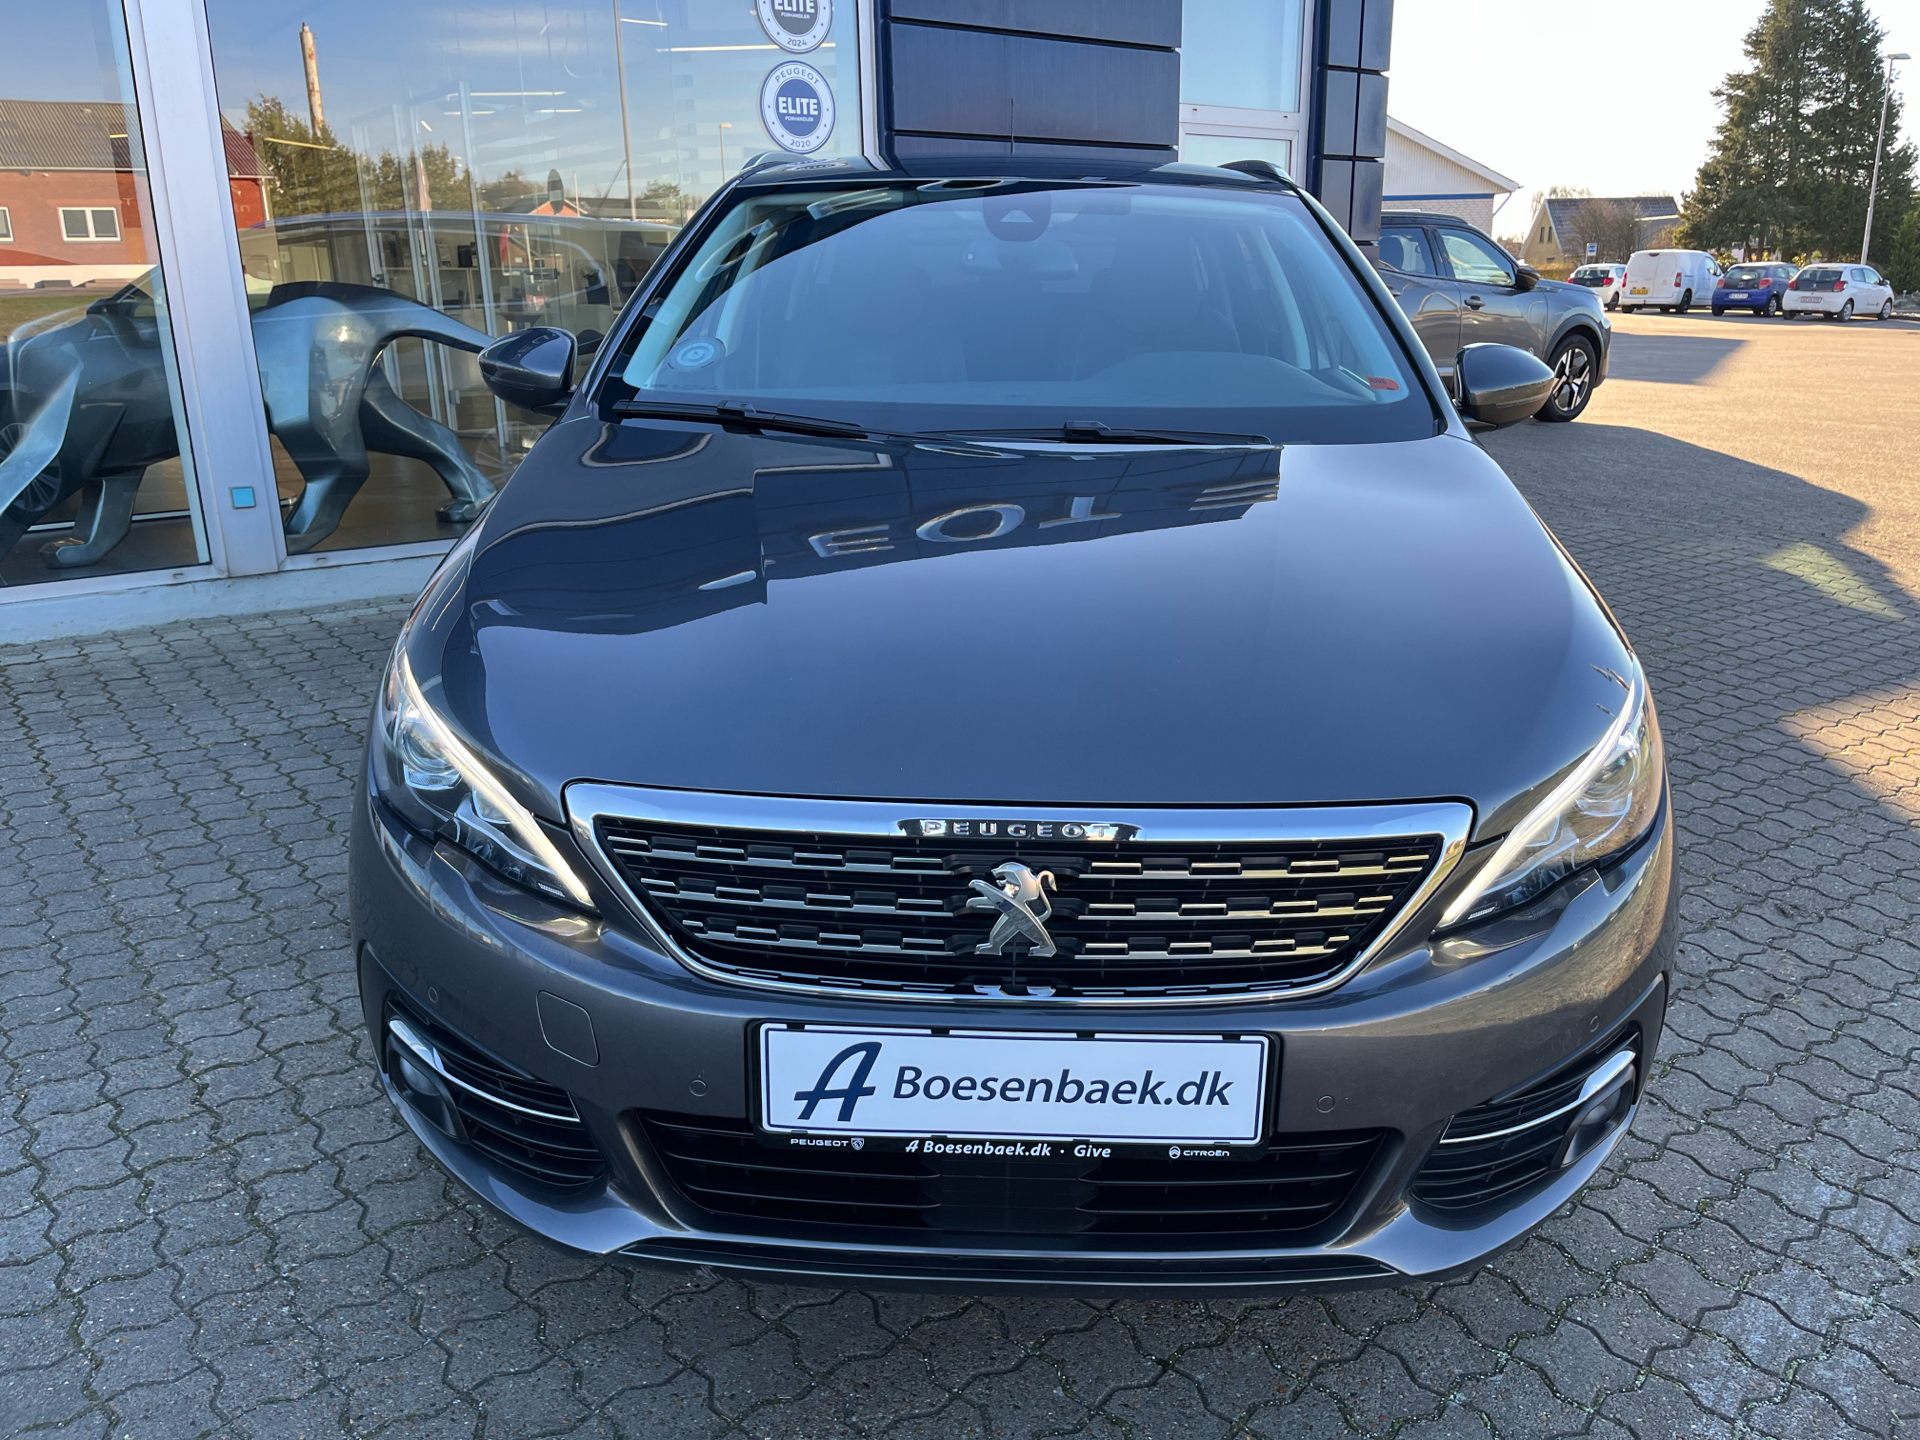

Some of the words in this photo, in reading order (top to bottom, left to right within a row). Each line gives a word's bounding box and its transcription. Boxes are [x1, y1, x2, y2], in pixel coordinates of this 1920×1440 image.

[774, 0, 815, 13] ELITE
[787, 38, 807, 47] 2024
[775, 67, 820, 84] PEUGEOT
[778, 96, 818, 115] ELITE
[790, 139, 811, 148] 2020
[924, 819, 1111, 838] PEUGEOT
[893, 1065, 1235, 1106] Boesenbaek.dk
[790, 1138, 849, 1147] PEUGEOT
[923, 1140, 1051, 1157] Boesenbaek.dk
[1074, 1144, 1111, 1158] Give
